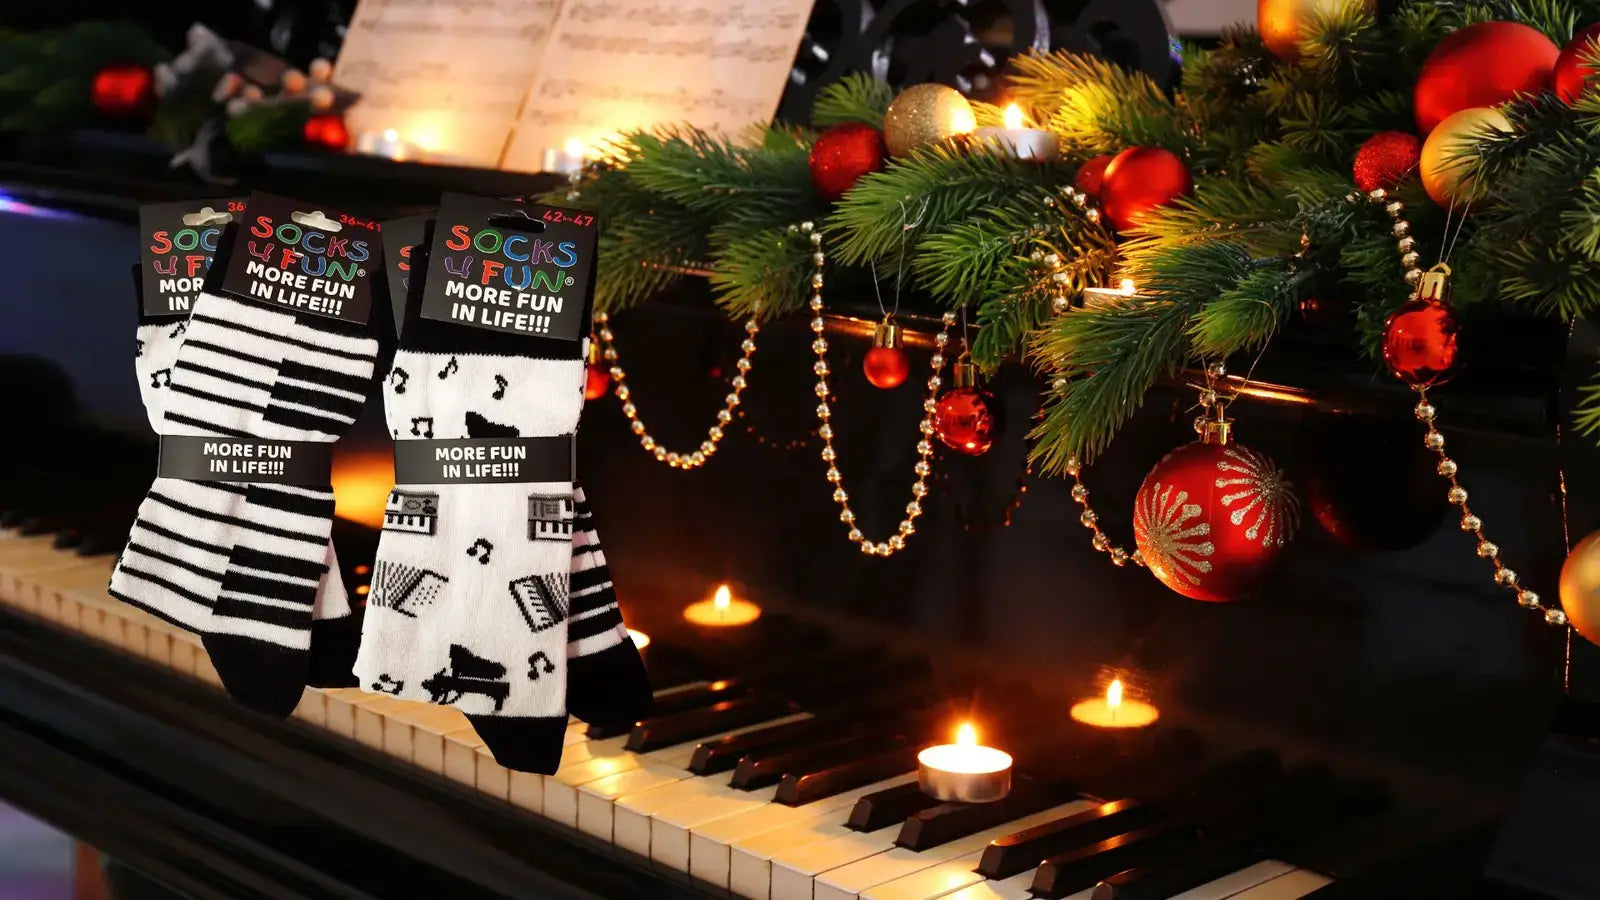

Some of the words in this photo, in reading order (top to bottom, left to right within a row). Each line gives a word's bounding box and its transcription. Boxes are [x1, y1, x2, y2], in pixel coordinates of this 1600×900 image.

[151, 229, 220, 254] SOC
[250, 216, 369, 261] SOCKS
[446, 225, 577, 268] SOCKS
[160, 277, 204, 293] MOR
[246, 261, 307, 289] MORE
[312, 278, 355, 299] FUN
[168, 296, 189, 311] IN
[250, 281, 272, 299] IN
[277, 288, 343, 315] LIFE!!!
[445, 280, 512, 307] MORE
[517, 293, 563, 314] FUN
[451, 302, 475, 322] IN
[481, 308, 550, 334] LIFE!!!
[203, 442, 253, 457] MORE
[258, 445, 292, 459] FUN
[435, 447, 486, 461] MORE
[490, 446, 526, 460] FUN
[210, 459, 228, 473] IN
[232, 460, 284, 475] LIFE!!!
[442, 464, 461, 478] IN
[466, 463, 519, 478] LIFE!!!
